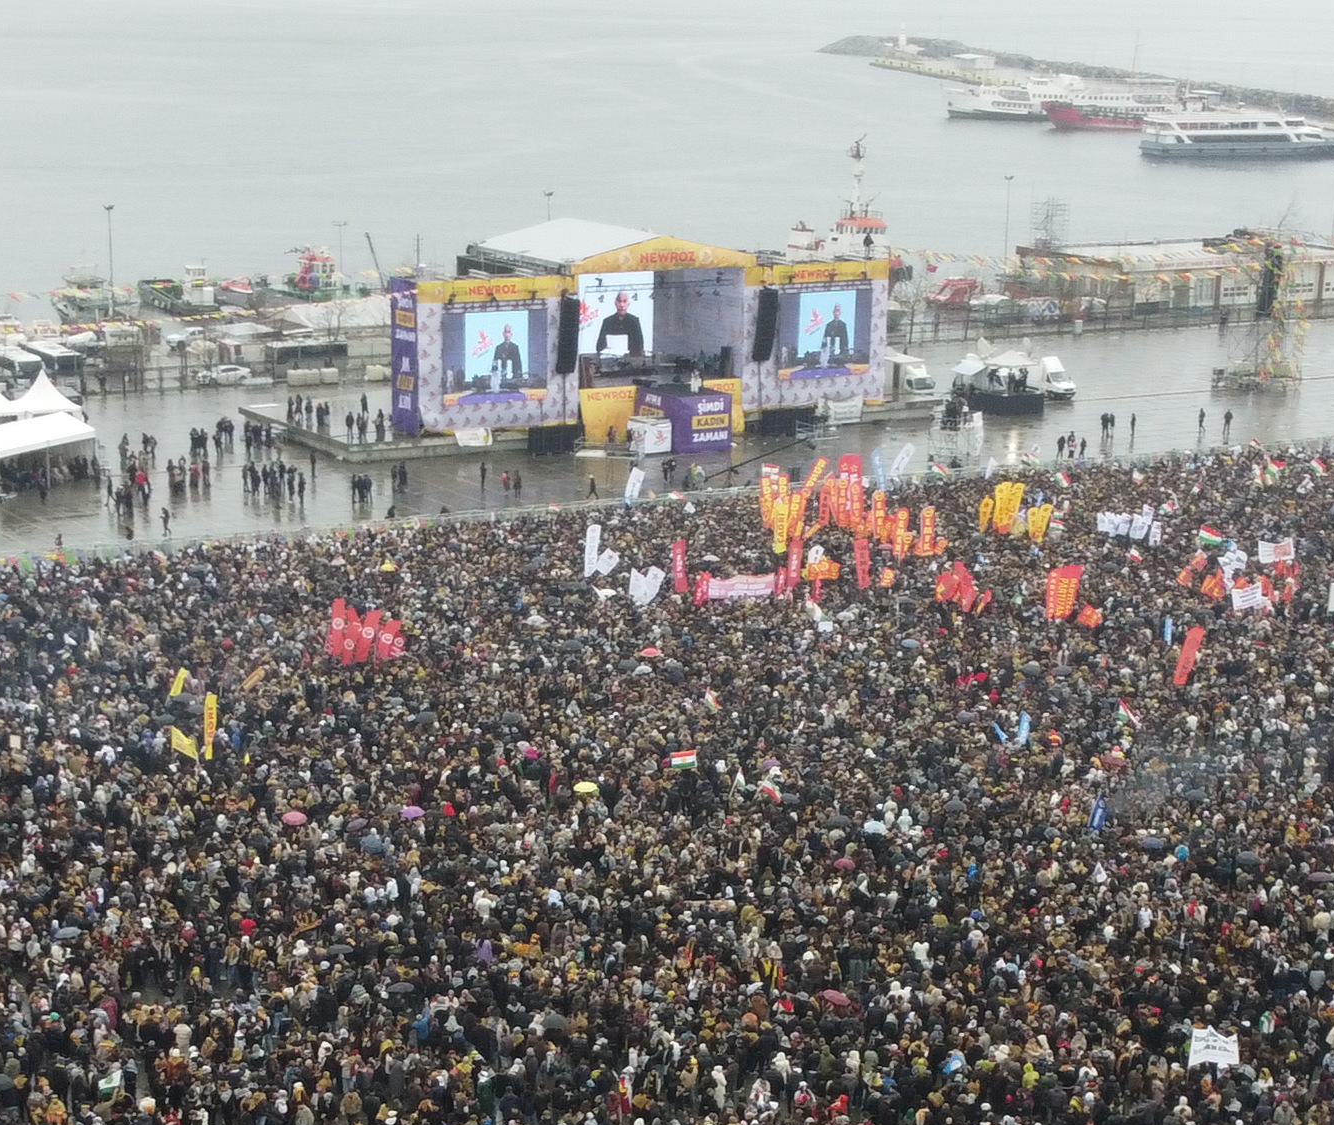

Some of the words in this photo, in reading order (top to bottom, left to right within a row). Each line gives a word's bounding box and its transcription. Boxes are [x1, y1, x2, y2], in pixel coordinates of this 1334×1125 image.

[640, 251, 696, 264] NEWROZ
[468, 284, 517, 296] NEWROZ
[587, 390, 634, 402] NEWROZ
[697, 398, 724, 415] ŞİMDİ
[696, 416, 725, 427] KADIN
[692, 430, 728, 443] ZAMANI
